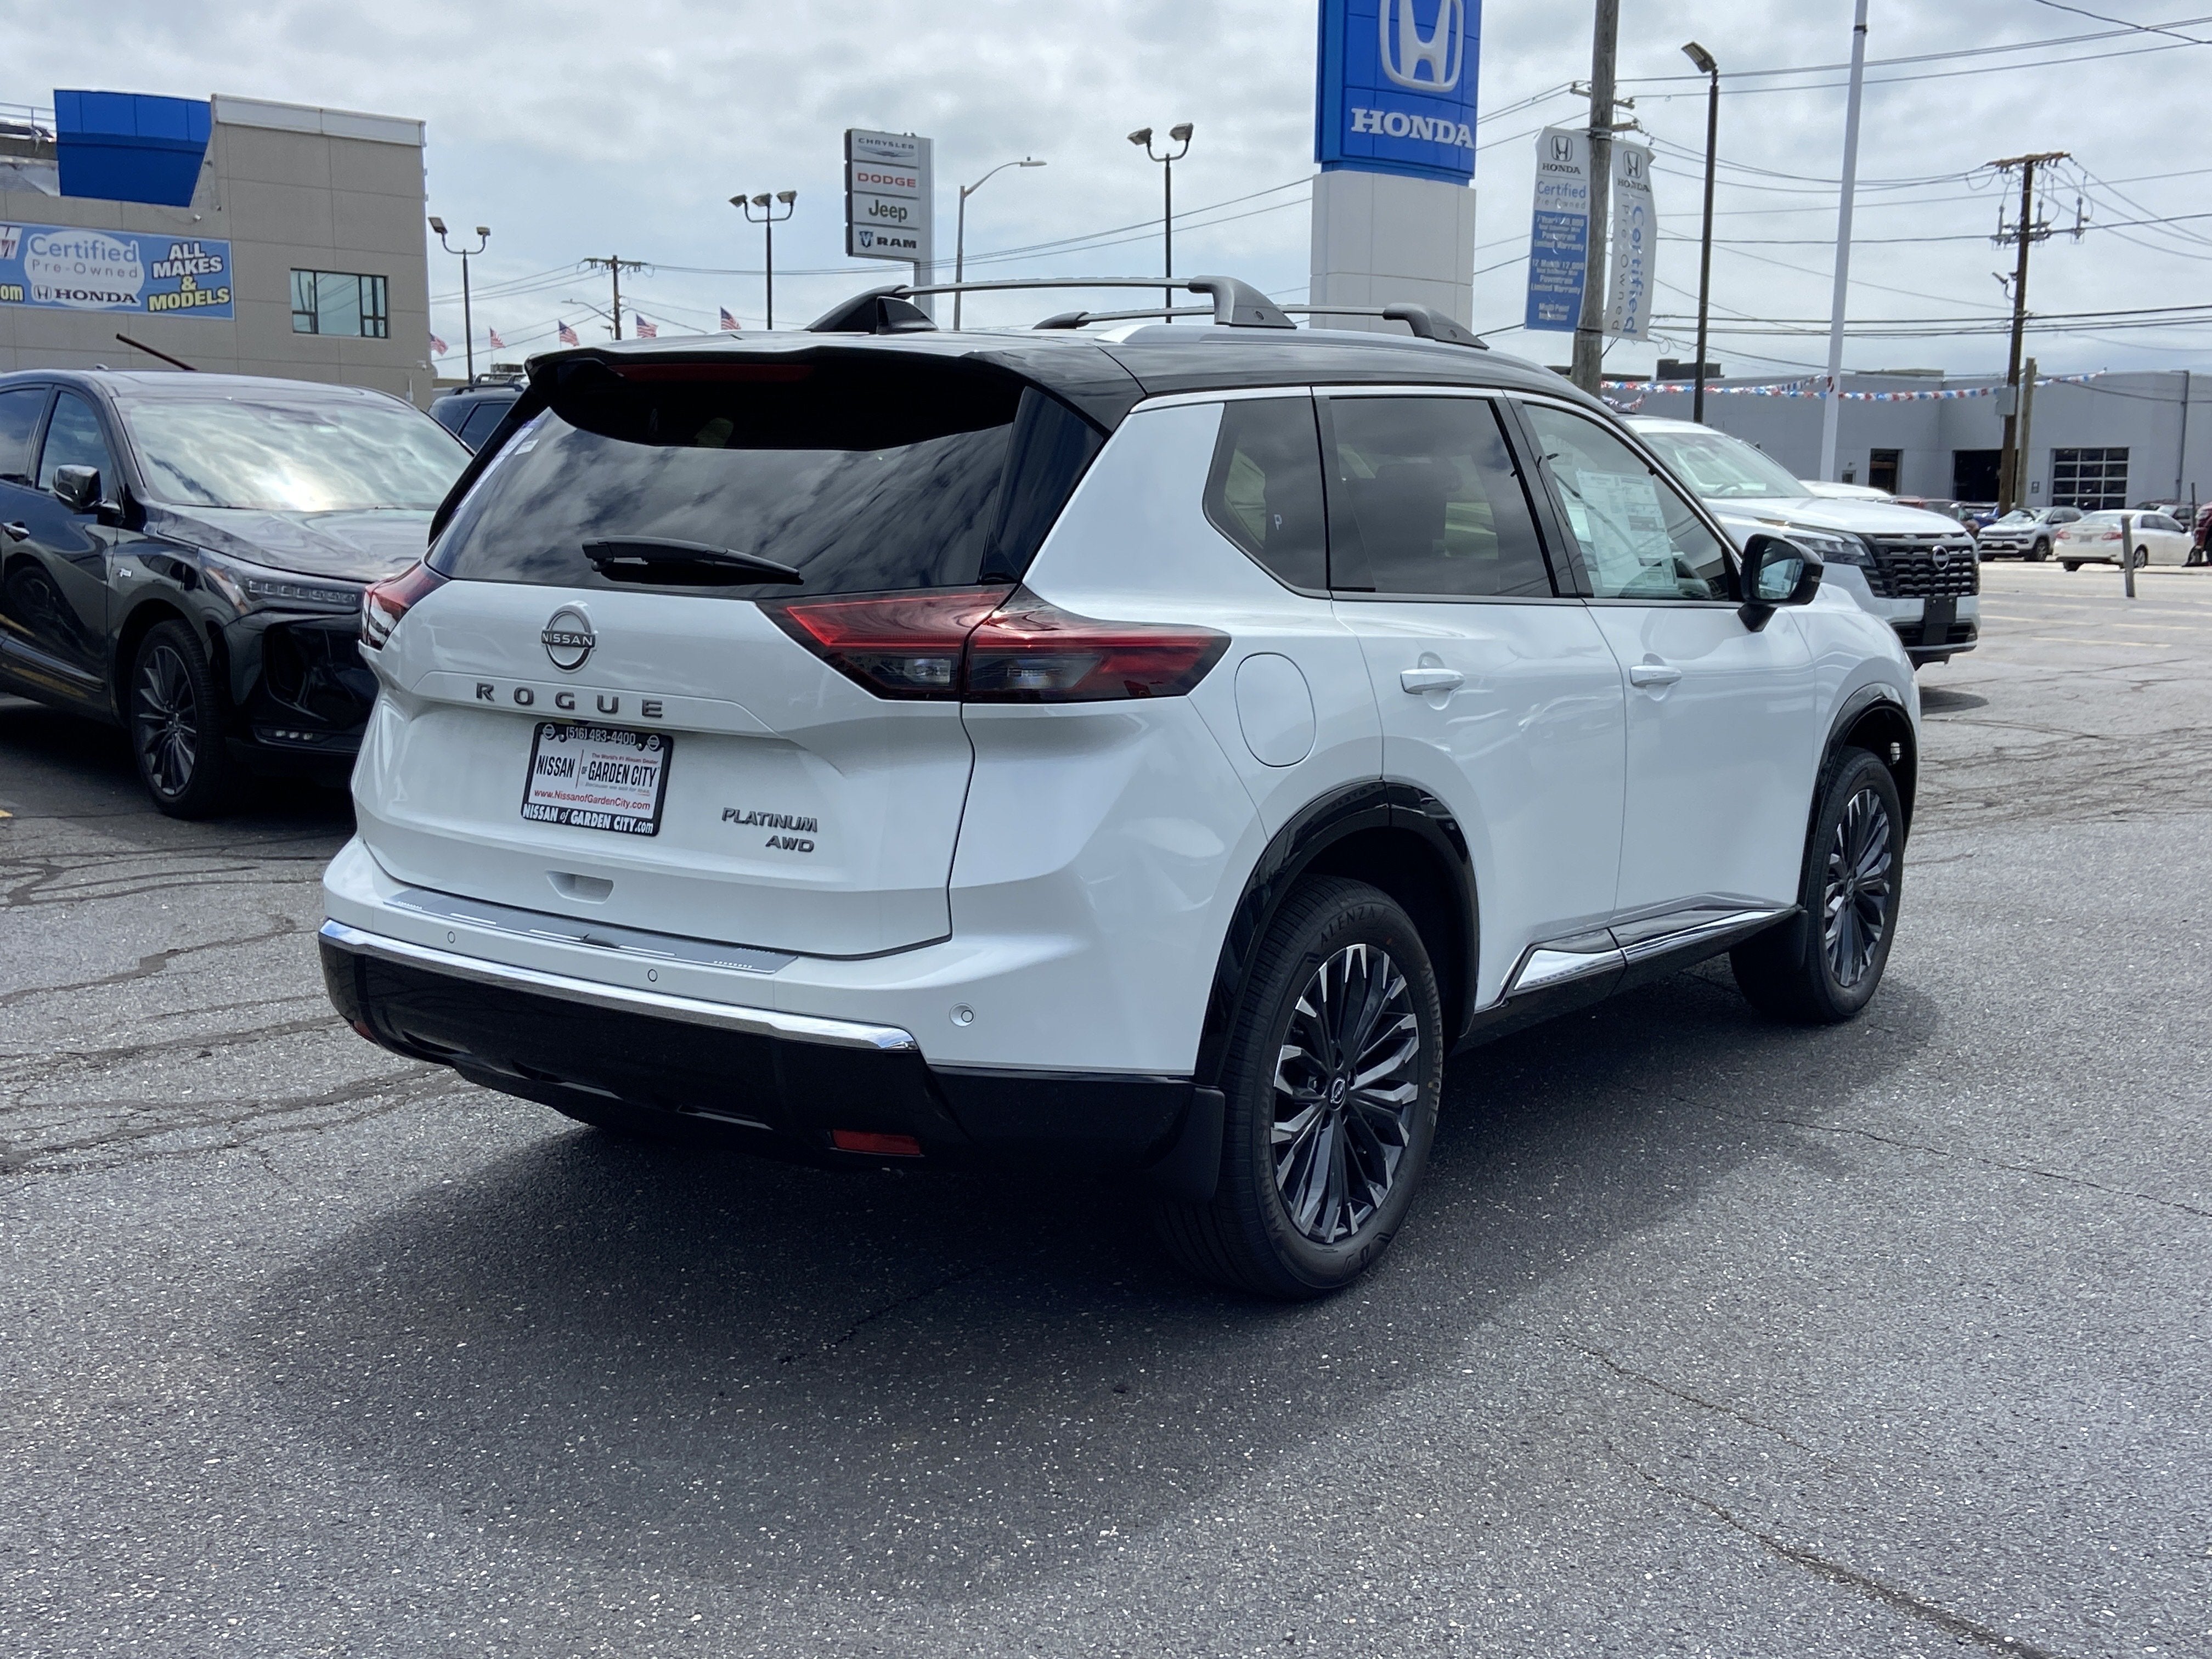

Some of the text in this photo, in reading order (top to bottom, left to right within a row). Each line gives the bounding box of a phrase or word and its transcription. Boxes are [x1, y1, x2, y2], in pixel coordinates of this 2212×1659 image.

[1351, 108, 1475, 149] HONDA
[859, 138, 915, 149] CHRYSLER
[1542, 163, 1581, 175] HONDA
[857, 172, 916, 188] DODGE
[1538, 180, 1586, 198] Certified
[1618, 179, 1651, 193] HONDA
[868, 199, 908, 223] Jeep
[30, 236, 137, 262] Certified
[170, 242, 206, 261] ALL
[877, 236, 917, 249] RAM
[32, 259, 137, 278] Pre-Owned
[153, 257, 223, 279] MAKES
[1611, 204, 1630, 330] PreOwned
[181, 275, 197, 292] &
[55, 288, 137, 303] HONDA
[148, 287, 231, 312] MODELS
[542, 631, 594, 646] NISSAN
[476, 682, 663, 718] ROGUE
[566, 726, 636, 745] (516) 483-4400
[536, 755, 575, 778] NISSAN
[588, 760, 630, 785] GARDEN
[631, 765, 657, 787] CITY
[534, 789, 651, 810] www.NissanofGardenCity.com
[523, 803, 653, 834] NISSAN of GARDEN CITY.com
[721, 807, 818, 833] PLATINUM
[765, 835, 815, 853] AWD
[1321, 905, 1375, 949] ALENZA
